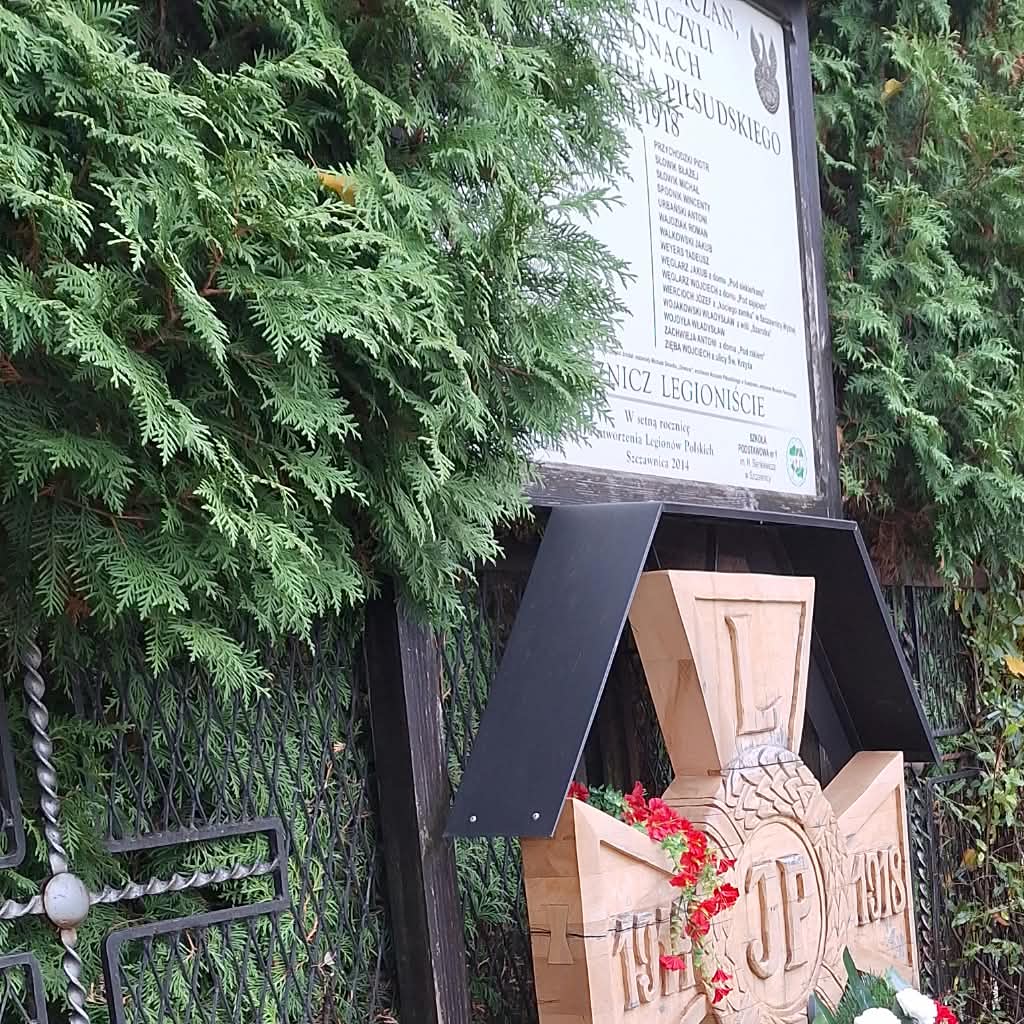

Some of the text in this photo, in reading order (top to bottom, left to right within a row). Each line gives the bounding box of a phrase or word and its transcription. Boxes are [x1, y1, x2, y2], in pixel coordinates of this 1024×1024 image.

[633, 0, 713, 54] ALCZYLI
[664, 73, 781, 155] PIŁSUDSKIEGO
[688, 223, 709, 239] ROMAN
[685, 249, 711, 266] TADEUSZ
[695, 239, 713, 254] JAKUB
[690, 265, 708, 279] JAKUB
[682, 344, 711, 360] WOJCIECH
[661, 375, 766, 418] LEGIONIŚCIE
[624, 409, 690, 437] W setną rocznicę
[645, 433, 681, 450] Legionów
[684, 439, 714, 456] Polskich
[626, 450, 690, 471] Szczawnica 2014
[850, 846, 907, 927] 1918
